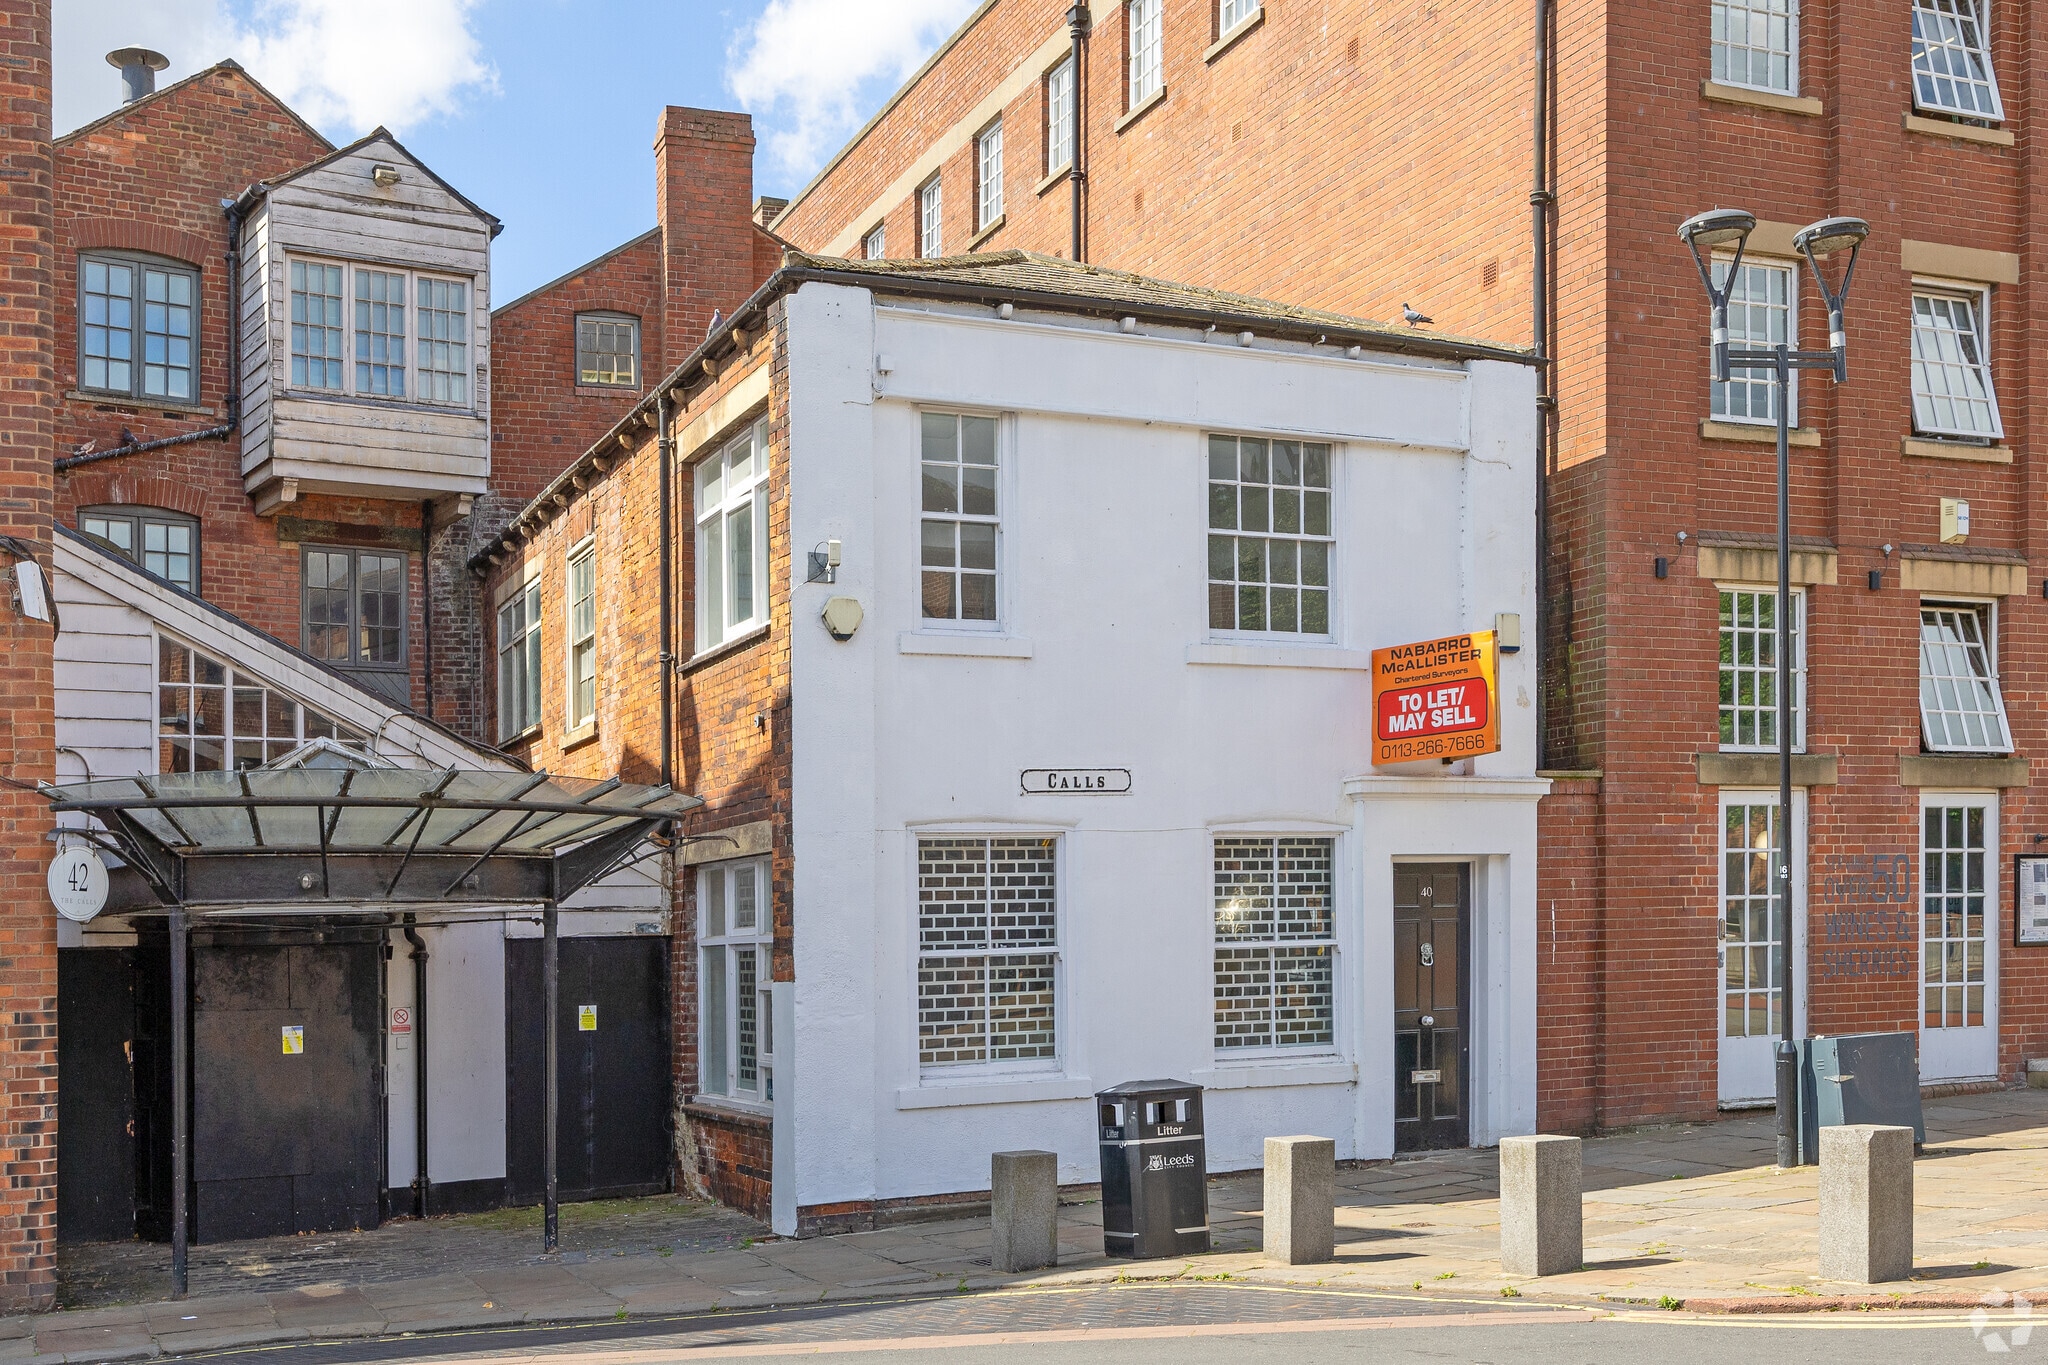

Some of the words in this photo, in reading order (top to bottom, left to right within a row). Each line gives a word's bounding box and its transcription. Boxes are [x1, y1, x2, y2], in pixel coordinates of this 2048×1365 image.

[1391, 637, 1471, 660] NABARRO
[1382, 649, 1482, 674] McALLISTER
[1395, 673, 1431, 684] Chartered
[1432, 668, 1468, 678] Surveyors
[1399, 693, 1422, 713] TO
[1427, 686, 1465, 709] LET/
[1389, 711, 1427, 733] MAY
[1431, 706, 1476, 728] SELL
[1381, 734, 1485, 760] 0113-266-7666
[1048, 773, 1105, 789] CALLS
[68, 862, 88, 892] 42
[1872, 854, 1911, 903] 50
[77, 897, 97, 906] CALLS
[1420, 887, 1432, 897] 40
[1824, 877, 1868, 903] OVER
[1824, 911, 1889, 942] WINES
[1895, 911, 1911, 940] &
[1823, 947, 1910, 978] SHERRIES
[1106, 1129, 1119, 1139] Litter
[1157, 1126, 1183, 1136] Litter
[1163, 1153, 1195, 1165] Leeds
